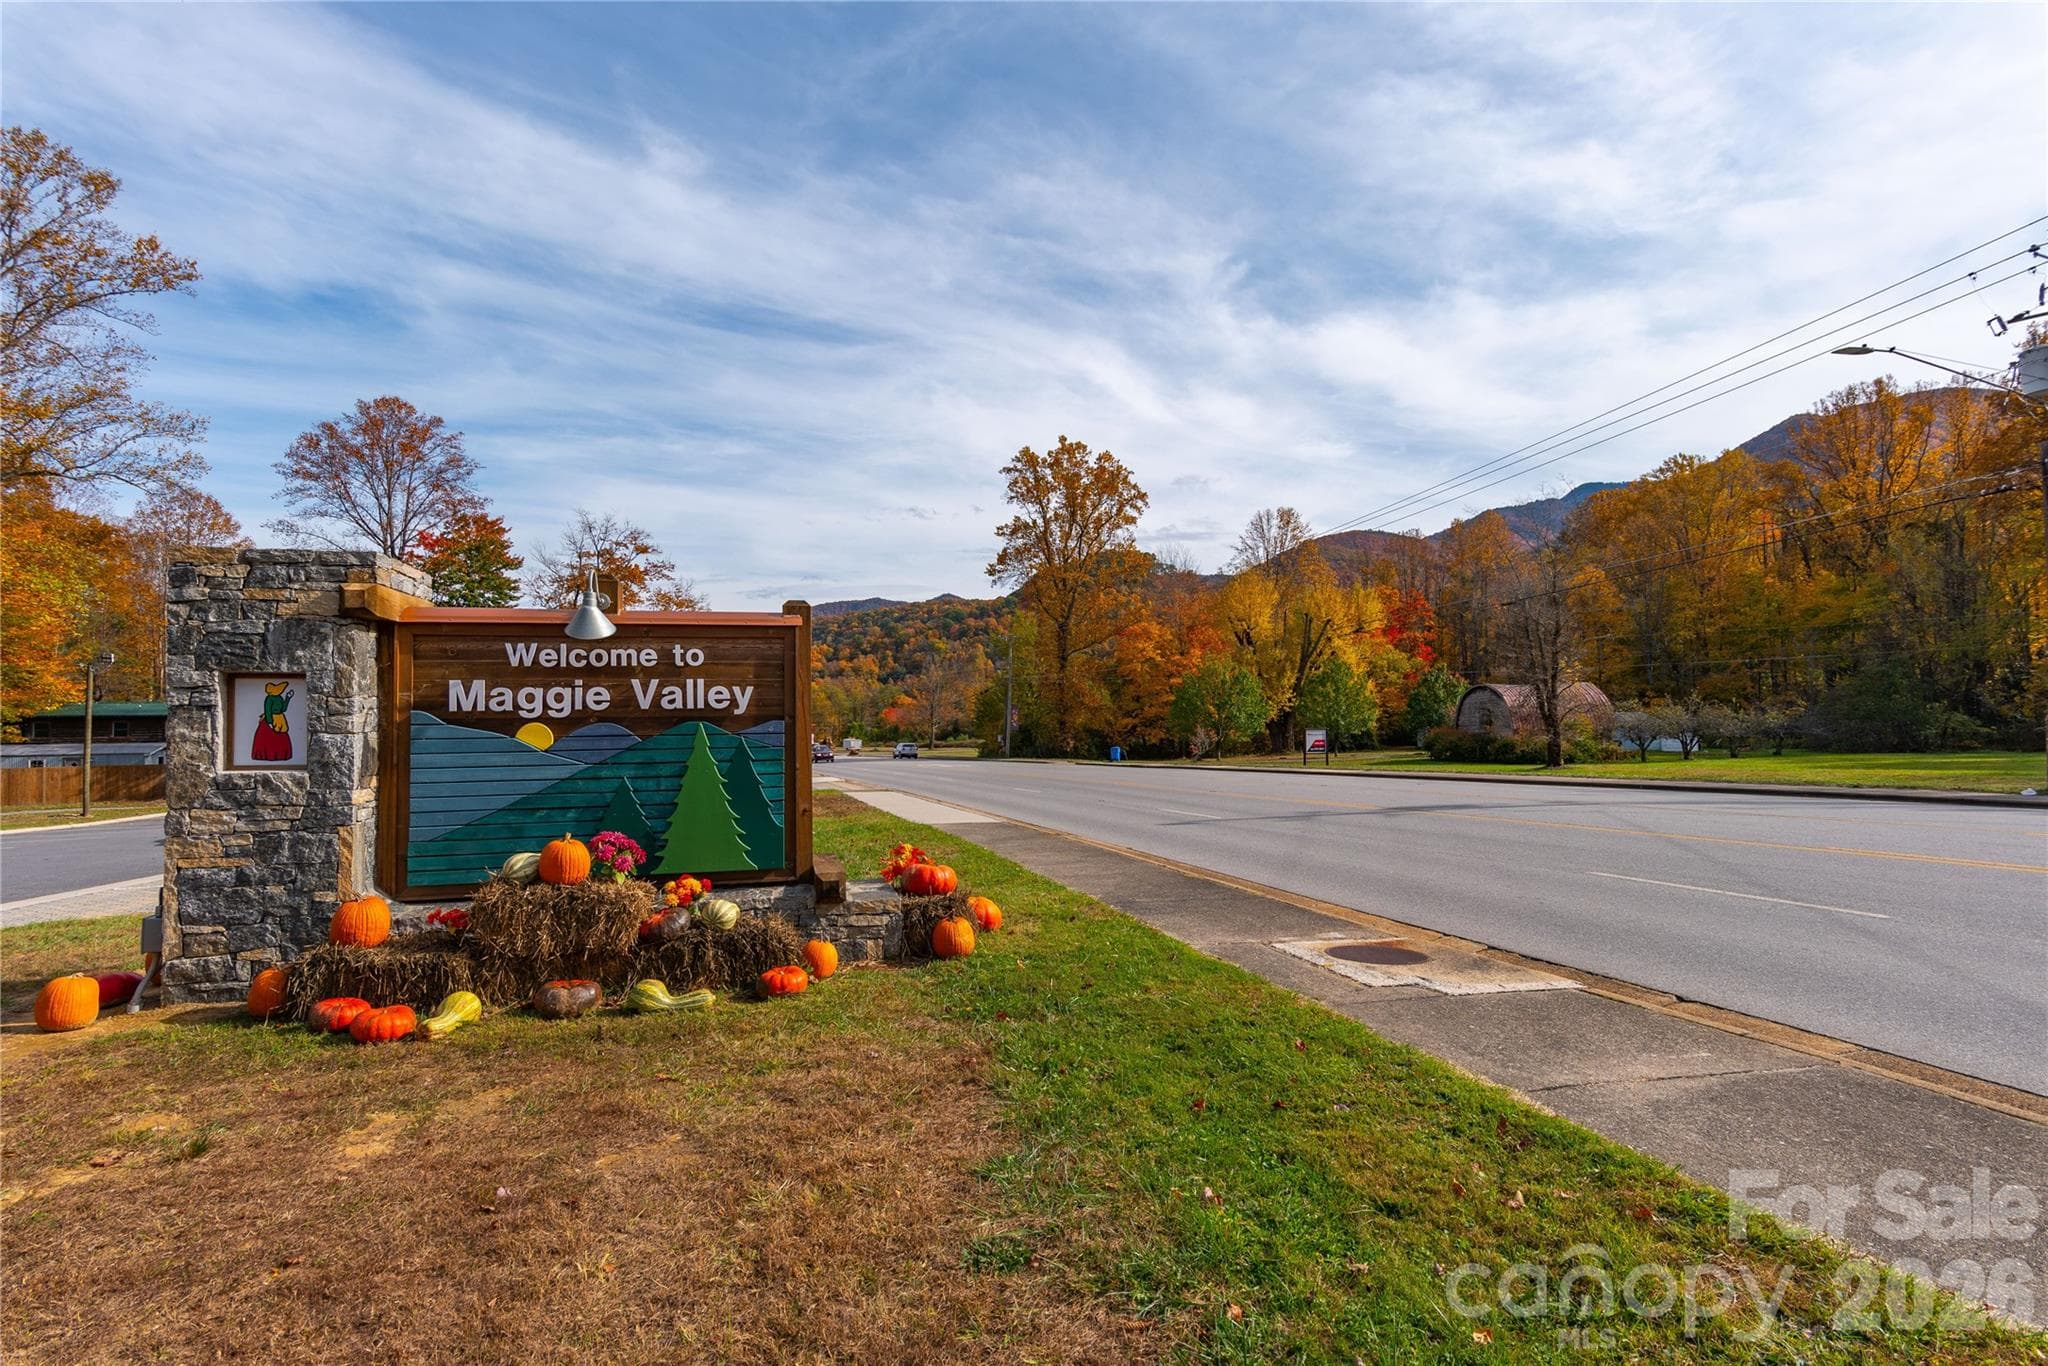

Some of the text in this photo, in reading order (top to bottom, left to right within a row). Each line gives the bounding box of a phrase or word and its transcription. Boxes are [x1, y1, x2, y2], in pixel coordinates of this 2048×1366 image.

[504, 642, 705, 667] Welcome to
[448, 678, 754, 718] Maggie Valley
